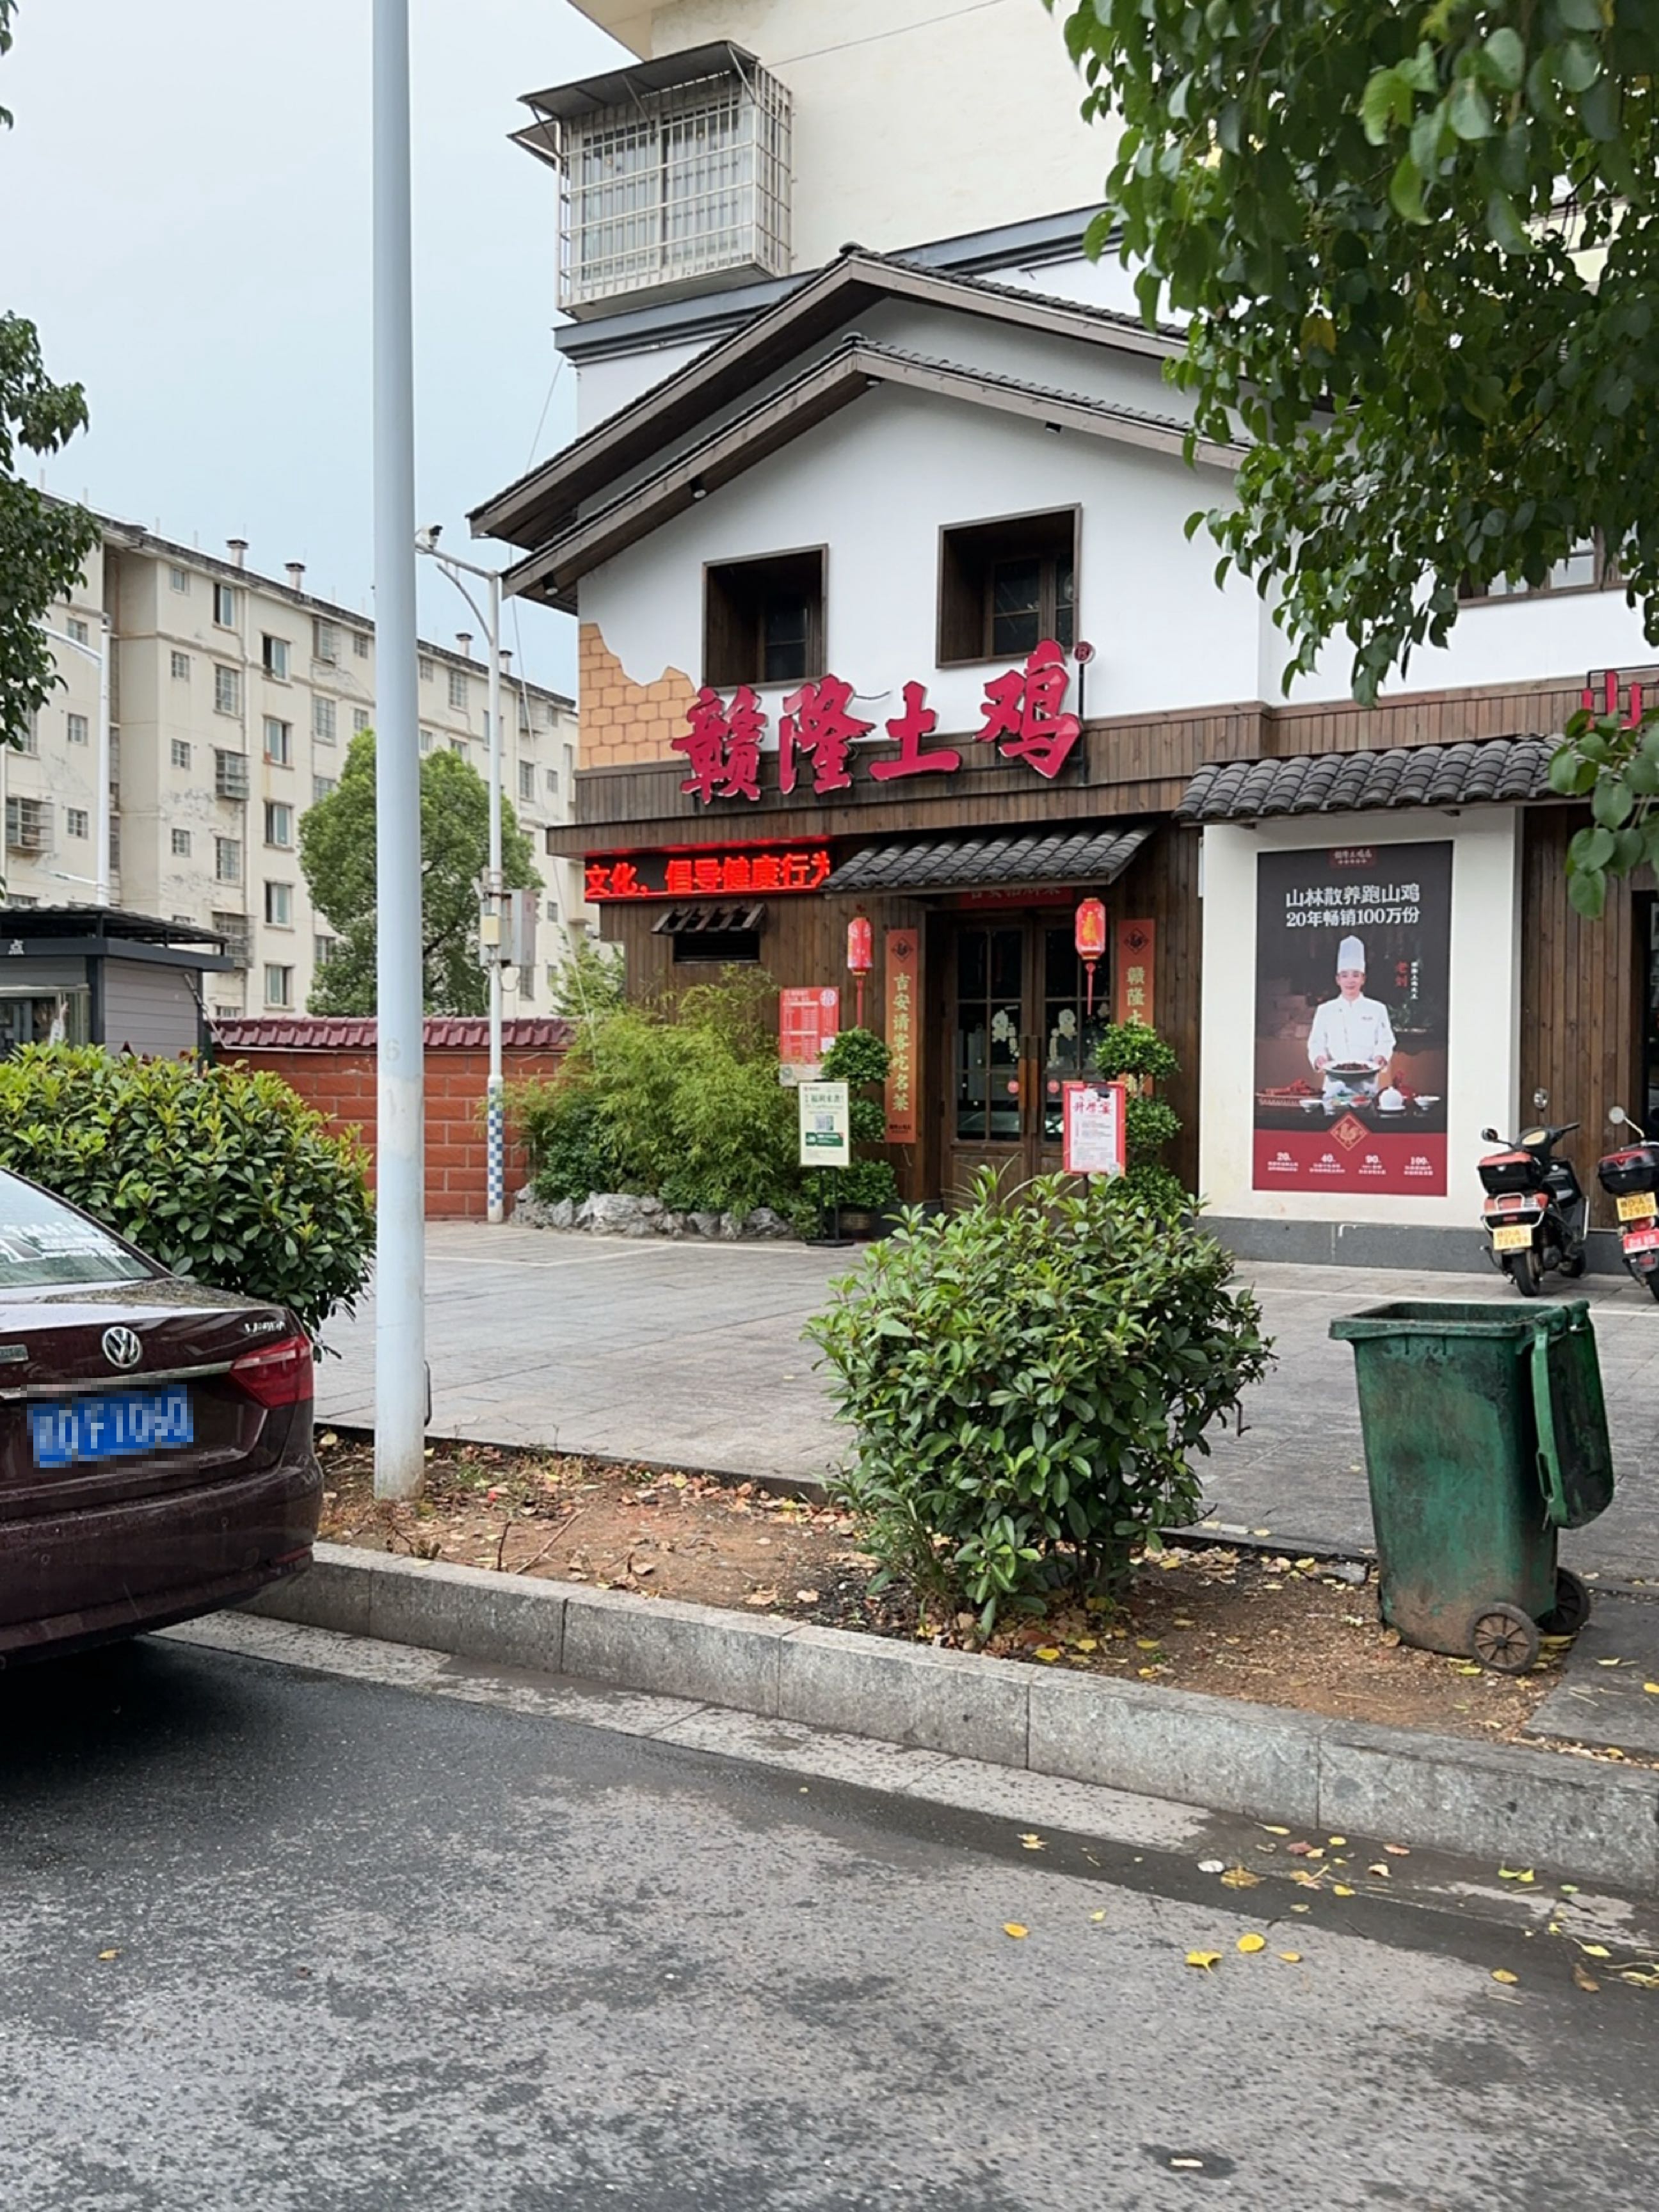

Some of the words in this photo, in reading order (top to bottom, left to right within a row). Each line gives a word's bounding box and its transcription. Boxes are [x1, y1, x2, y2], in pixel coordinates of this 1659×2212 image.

[673, 639, 1083, 805] 赣隆土鸡
[1286, 883, 1420, 908] 山林散养跑山鸡
[1286, 906, 1420, 927] 20年畅销100万份
